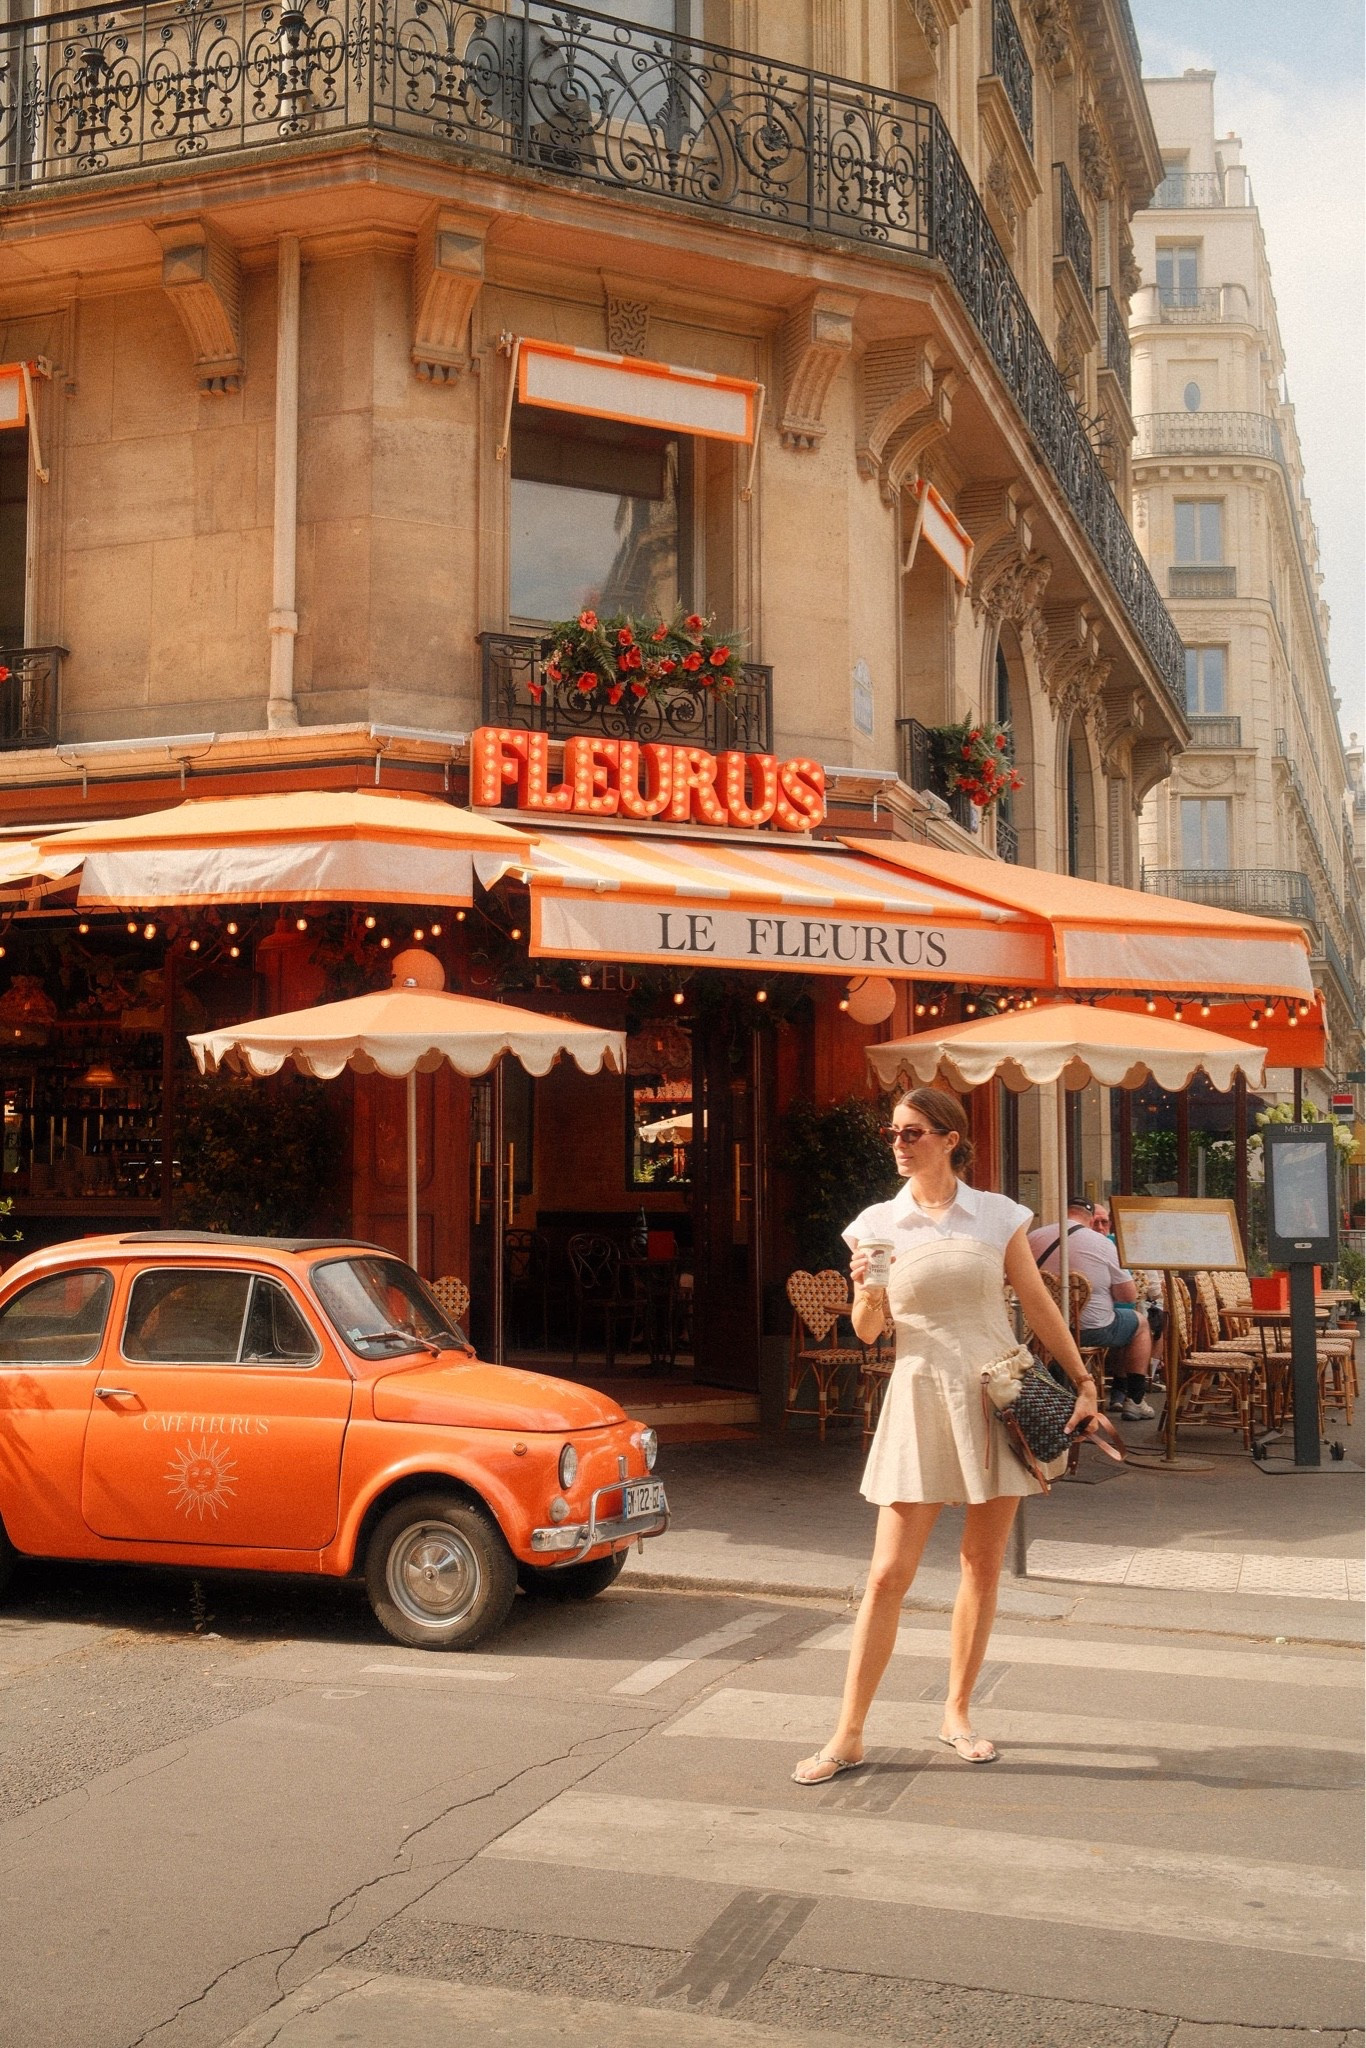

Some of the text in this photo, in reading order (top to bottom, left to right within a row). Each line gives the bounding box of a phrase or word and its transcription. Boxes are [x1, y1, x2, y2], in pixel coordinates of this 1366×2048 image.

[472, 726, 825, 832] FLEURUS
[657, 912, 948, 968] LE FLEURUS
[1284, 1124, 1313, 1133] MENU
[190, 1415, 271, 1435] FLEURUS
